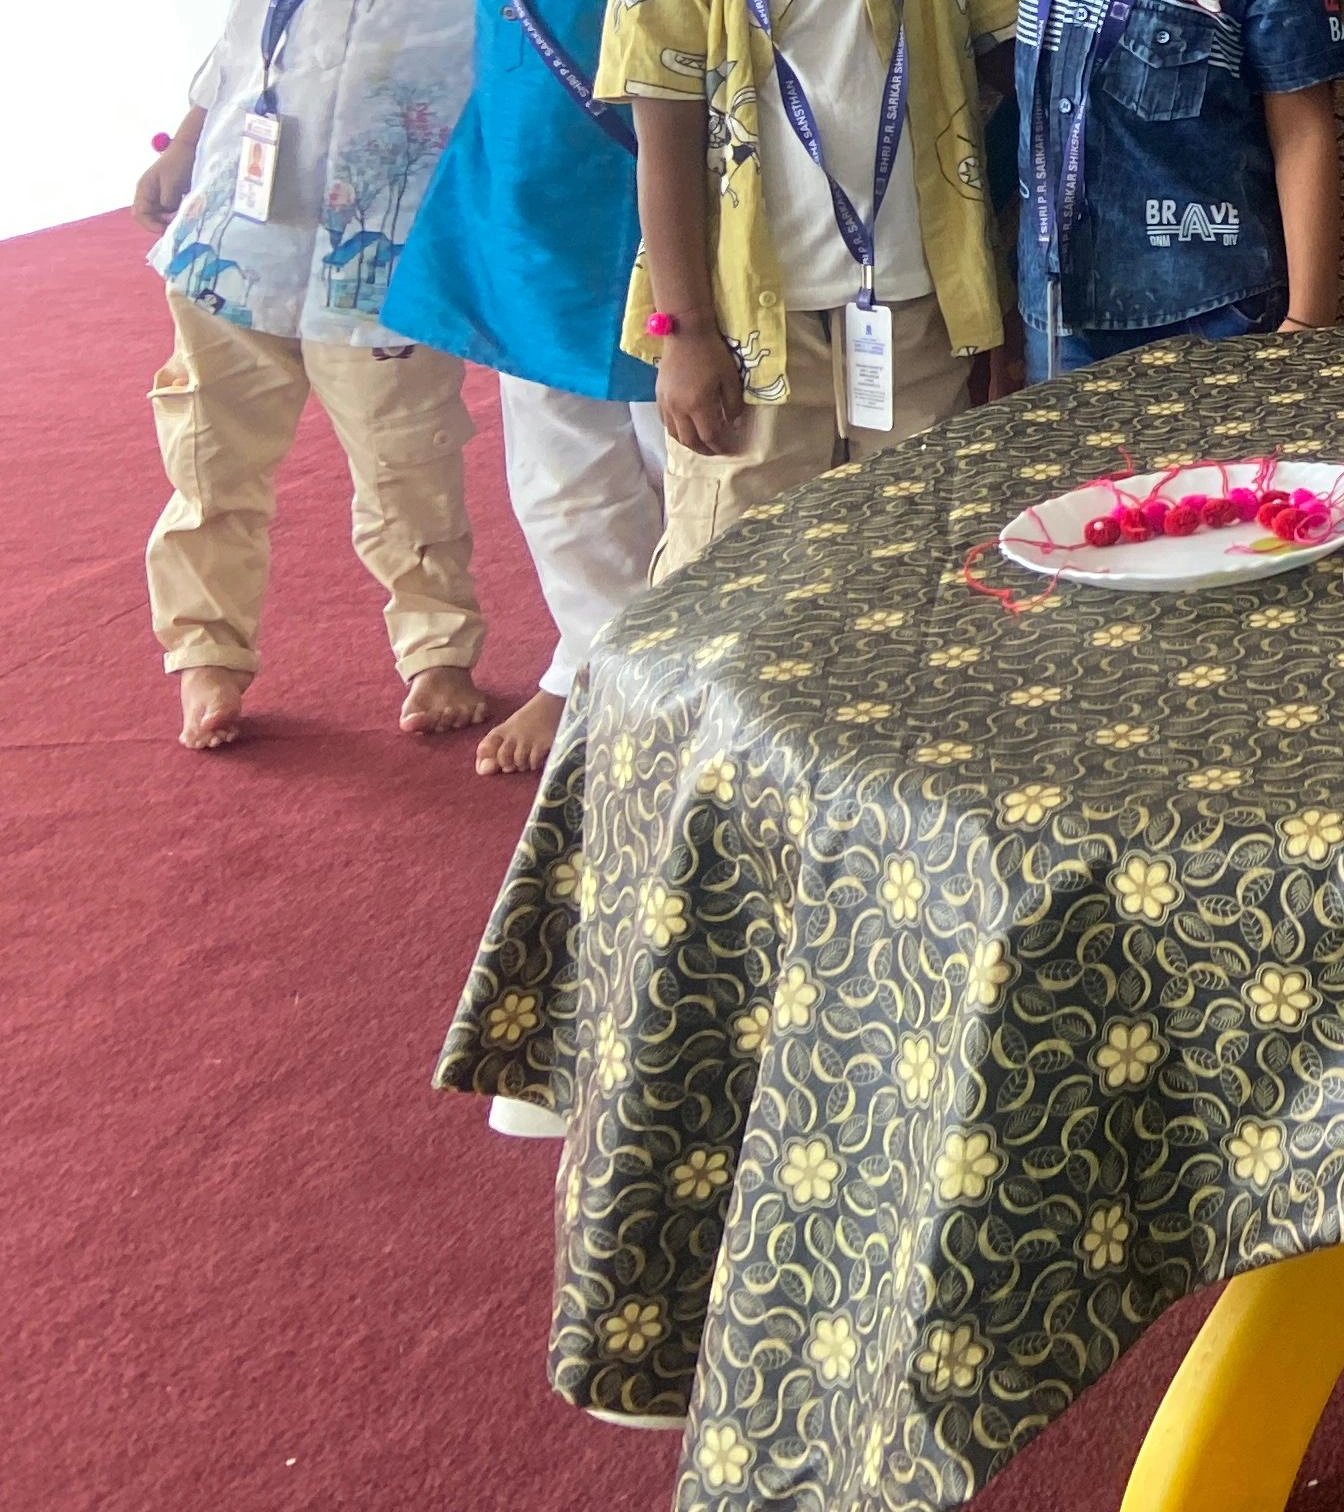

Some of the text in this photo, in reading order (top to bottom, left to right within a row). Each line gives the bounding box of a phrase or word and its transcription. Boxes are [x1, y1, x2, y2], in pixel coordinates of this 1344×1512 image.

[785, 79, 815, 140] SANSTHAN
[886, 75, 903, 121] SARKAR
[1034, 138, 1047, 180] SARKAR
[1068, 121, 1082, 173] SHIKSHA
[1063, 173, 1078, 218] SARKAR
[1037, 207, 1049, 234] SHRI
[1146, 199, 1240, 242] BRAVE
